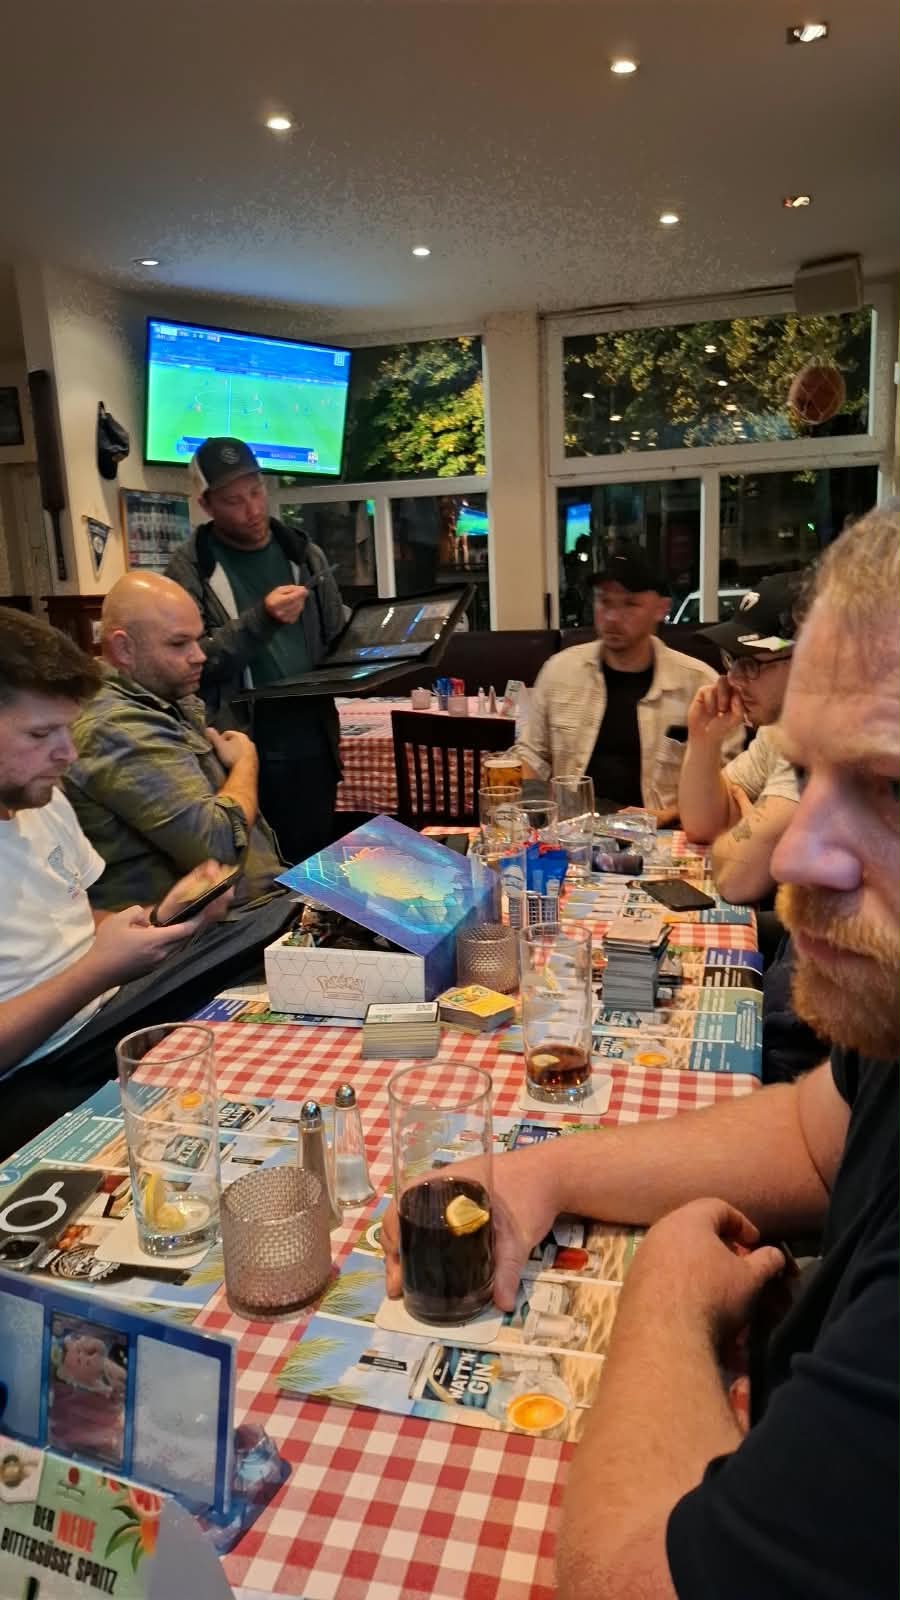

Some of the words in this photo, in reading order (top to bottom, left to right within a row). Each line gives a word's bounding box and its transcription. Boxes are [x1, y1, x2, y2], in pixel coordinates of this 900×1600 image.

[468, 1362, 495, 1394] GIN
[33, 1504, 56, 1532] DER
[75, 1557, 118, 1595] SPRITZ
